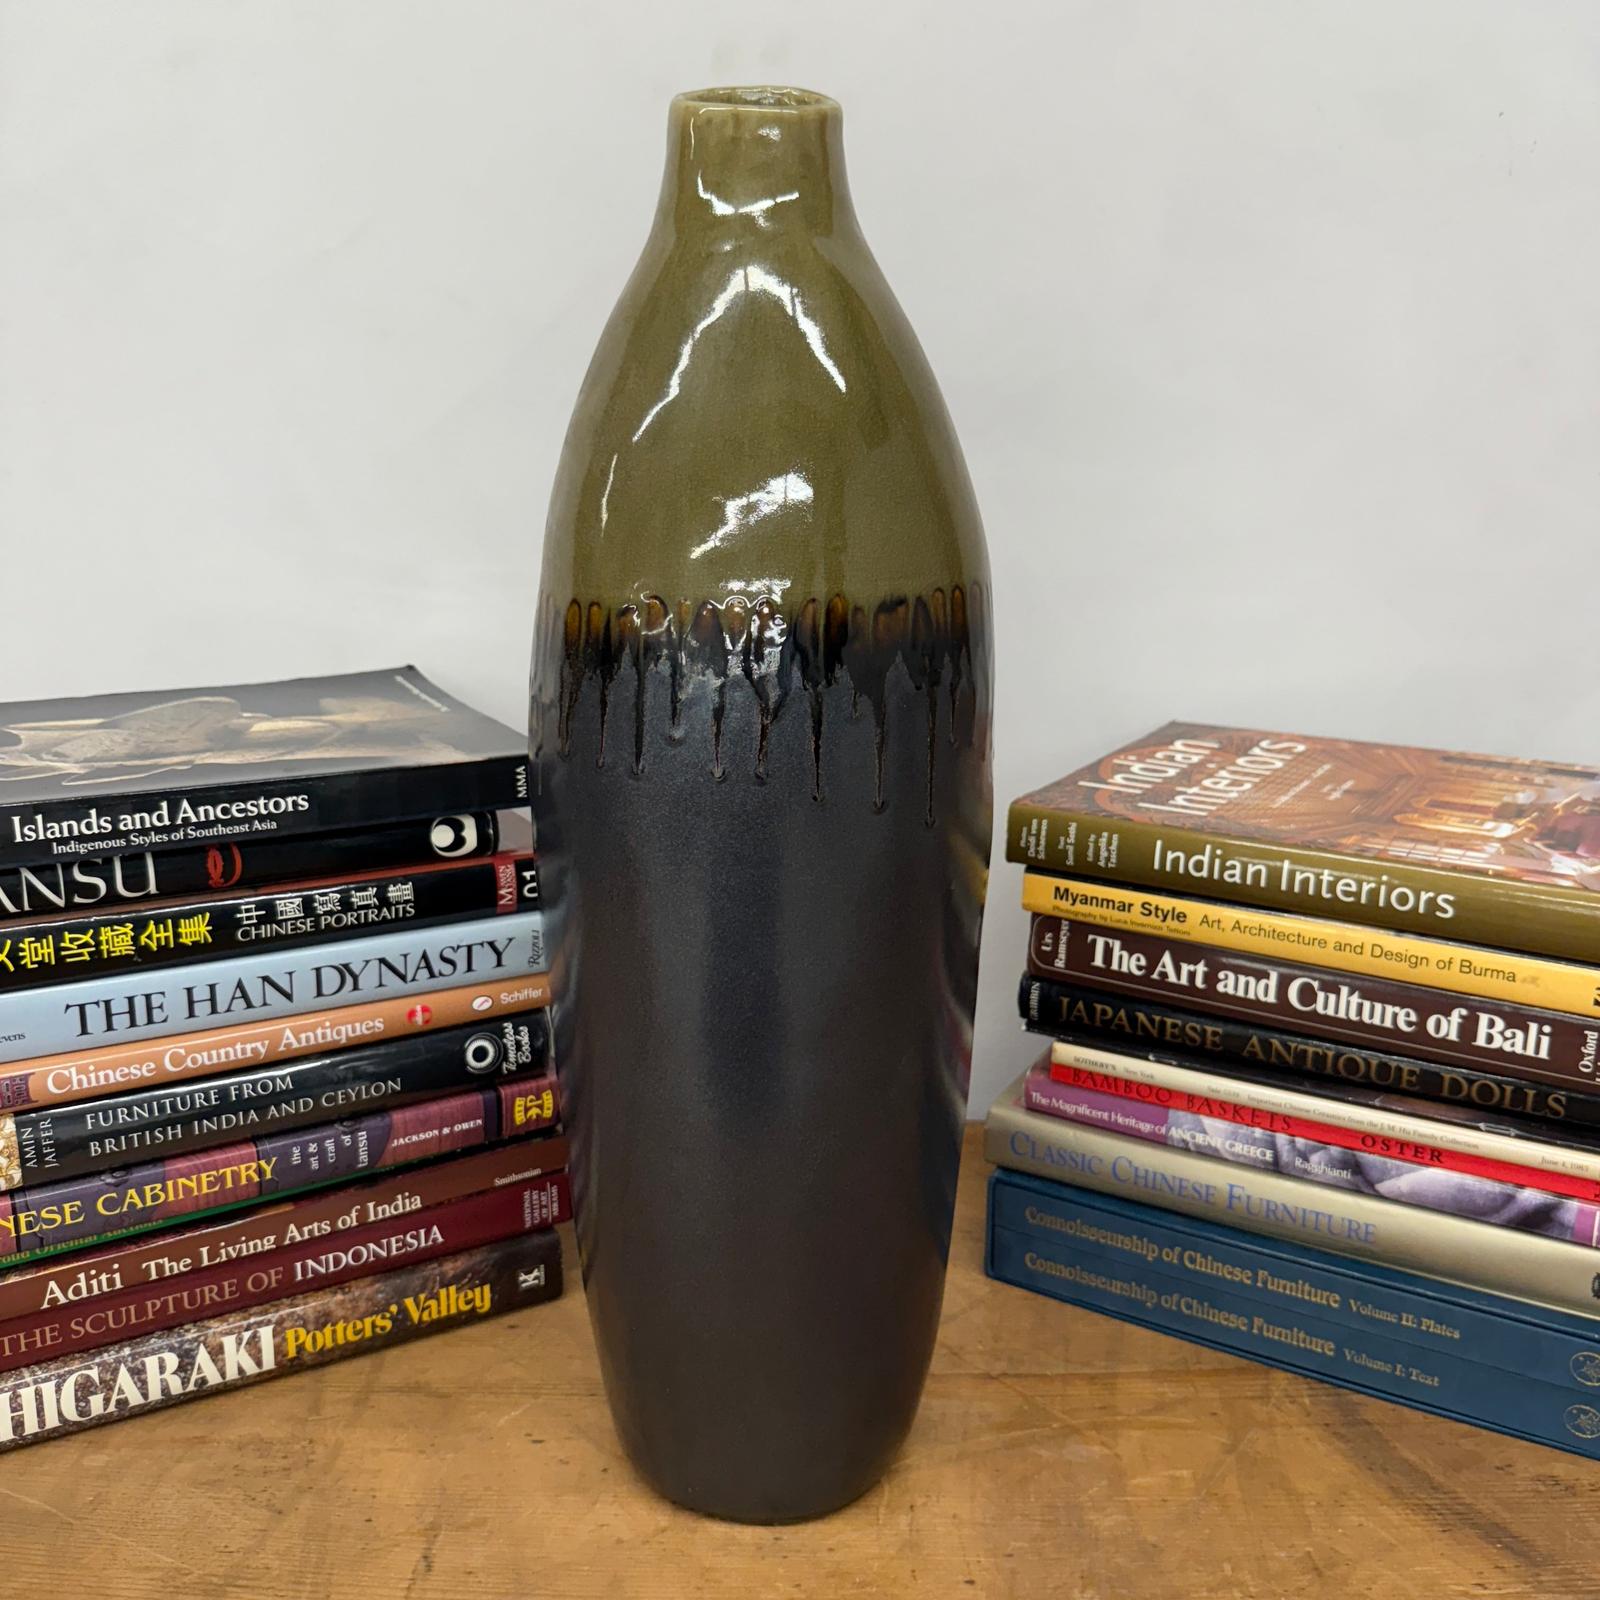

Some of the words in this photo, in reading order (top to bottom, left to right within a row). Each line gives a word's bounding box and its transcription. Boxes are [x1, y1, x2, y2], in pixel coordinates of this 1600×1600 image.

[515, 766, 527, 798] MMA
[1078, 738, 1222, 795] Indian
[1137, 739, 1306, 816] Interiors
[12, 809, 112, 843] Islands
[119, 801, 171, 831] and
[176, 794, 309, 825] Ancestors
[53, 838, 126, 855] Indigenous
[130, 831, 168, 847] Styles
[172, 827, 186, 840] of
[187, 822, 249, 839] Southeast
[252, 820, 277, 832] Asia
[1107, 833, 1118, 868] Taschen
[1153, 839, 1268, 888] Indian
[1280, 859, 1455, 919] Interiors
[237, 917, 315, 942] CHINESE
[321, 903, 415, 930] PORTRAITS
[1053, 906, 1096, 921] Photography
[1099, 914, 1109, 923] by
[1054, 886, 1132, 914] Myanmar
[1140, 901, 1187, 924] Style
[1199, 914, 1225, 932] Art,
[1230, 919, 1327, 948] Architecture
[1333, 939, 1363, 955] and
[1370, 944, 1429, 968] Design
[1436, 957, 1452, 971] of
[1459, 960, 1516, 983] Burma
[1042, 932, 1053, 951] Urs
[65, 991, 168, 1037] THE
[183, 971, 296, 1019] HAN
[312, 937, 515, 1000] DYNASTY
[501, 987, 542, 1004] Schiffer
[1087, 934, 1146, 976] The
[1153, 950, 1208, 990] Art
[1216, 970, 1277, 1003] and
[1287, 977, 1417, 1032] Culture
[1426, 1007, 1469, 1042] of
[1472, 1012, 1551, 1060] Bali
[47, 1060, 156, 1094] Chinese
[164, 1039, 269, 1073] Country
[279, 1017, 384, 1050] Antiques
[503, 1022, 517, 1074] Timeless
[518, 1025, 531, 1063] Books
[1059, 996, 1224, 1051] JAPANESE
[1242, 1035, 1420, 1091] ANTIQUE
[1440, 1071, 1566, 1119] DOLLS
[1579, 1030, 1599, 1073] Oxford
[86, 1089, 219, 1130] FURNITURE
[231, 1075, 293, 1102] FROM
[90, 1124, 182, 1157] BRITISH
[194, 1112, 259, 1135] INDIA
[268, 1096, 313, 1120] AND
[322, 1077, 401, 1108] CEYLON
[1072, 1064, 1173, 1104] BAMBOO
[1186, 1094, 1291, 1130] BASKETS
[1361, 1134, 1444, 1164] OSTER
[21, 1126, 37, 1168] AMIN
[39, 1118, 57, 1168] JAFFER
[291, 1146, 300, 1164] the
[324, 1139, 335, 1162] craft
[341, 1132, 351, 1146] of
[357, 1131, 368, 1167] tansu
[391, 1130, 440, 1147] JACKSON
[442, 1125, 450, 1134] &
[455, 1119, 482, 1132] OWEN
[1031, 1092, 1051, 1107] The
[1051, 1097, 1110, 1121] Magnificent
[1111, 1111, 1154, 1134] Heritage
[1155, 1123, 1168, 1135] of
[1168, 1126, 1225, 1151] ANCIENT
[1225, 1140, 1274, 1162] GREECE
[1294, 1156, 1352, 1181] Ragghianti
[1348, 1115, 1365, 1126] from
[1366, 1119, 1378, 1129] the
[1440, 1134, 1480, 1150] Collection
[97, 1157, 277, 1216] CABINETRY
[310, 1156, 319, 1170] art
[40, 1264, 123, 1309] Aditi
[142, 1254, 192, 1280] The
[200, 1237, 276, 1266] Living
[284, 1218, 330, 1245] Arts
[338, 1206, 361, 1229] of
[367, 1192, 422, 1223] India
[1025, 1206, 1159, 1261] Connoisseurship
[1161, 1246, 1182, 1264] of
[1183, 1250, 1253, 1285] Chinese
[1257, 1270, 1340, 1309] Furniture
[1349, 1299, 1397, 1324] Volume
[1420, 1317, 1460, 1339] Plates
[1, 1325, 62, 1356] THE
[70, 1279, 240, 1339] SCULPTURE
[247, 1267, 284, 1292] OF
[294, 1224, 444, 1281] INDONESIA
[403, 1283, 491, 1325] Valley
[1024, 1252, 1158, 1307] Connoisseurship
[1160, 1293, 1179, 1311] of
[1180, 1297, 1248, 1332] Chinese
[1252, 1317, 1335, 1356] Furniture
[1343, 1348, 1392, 1374] Volume
[1408, 1368, 1440, 1387] Text
